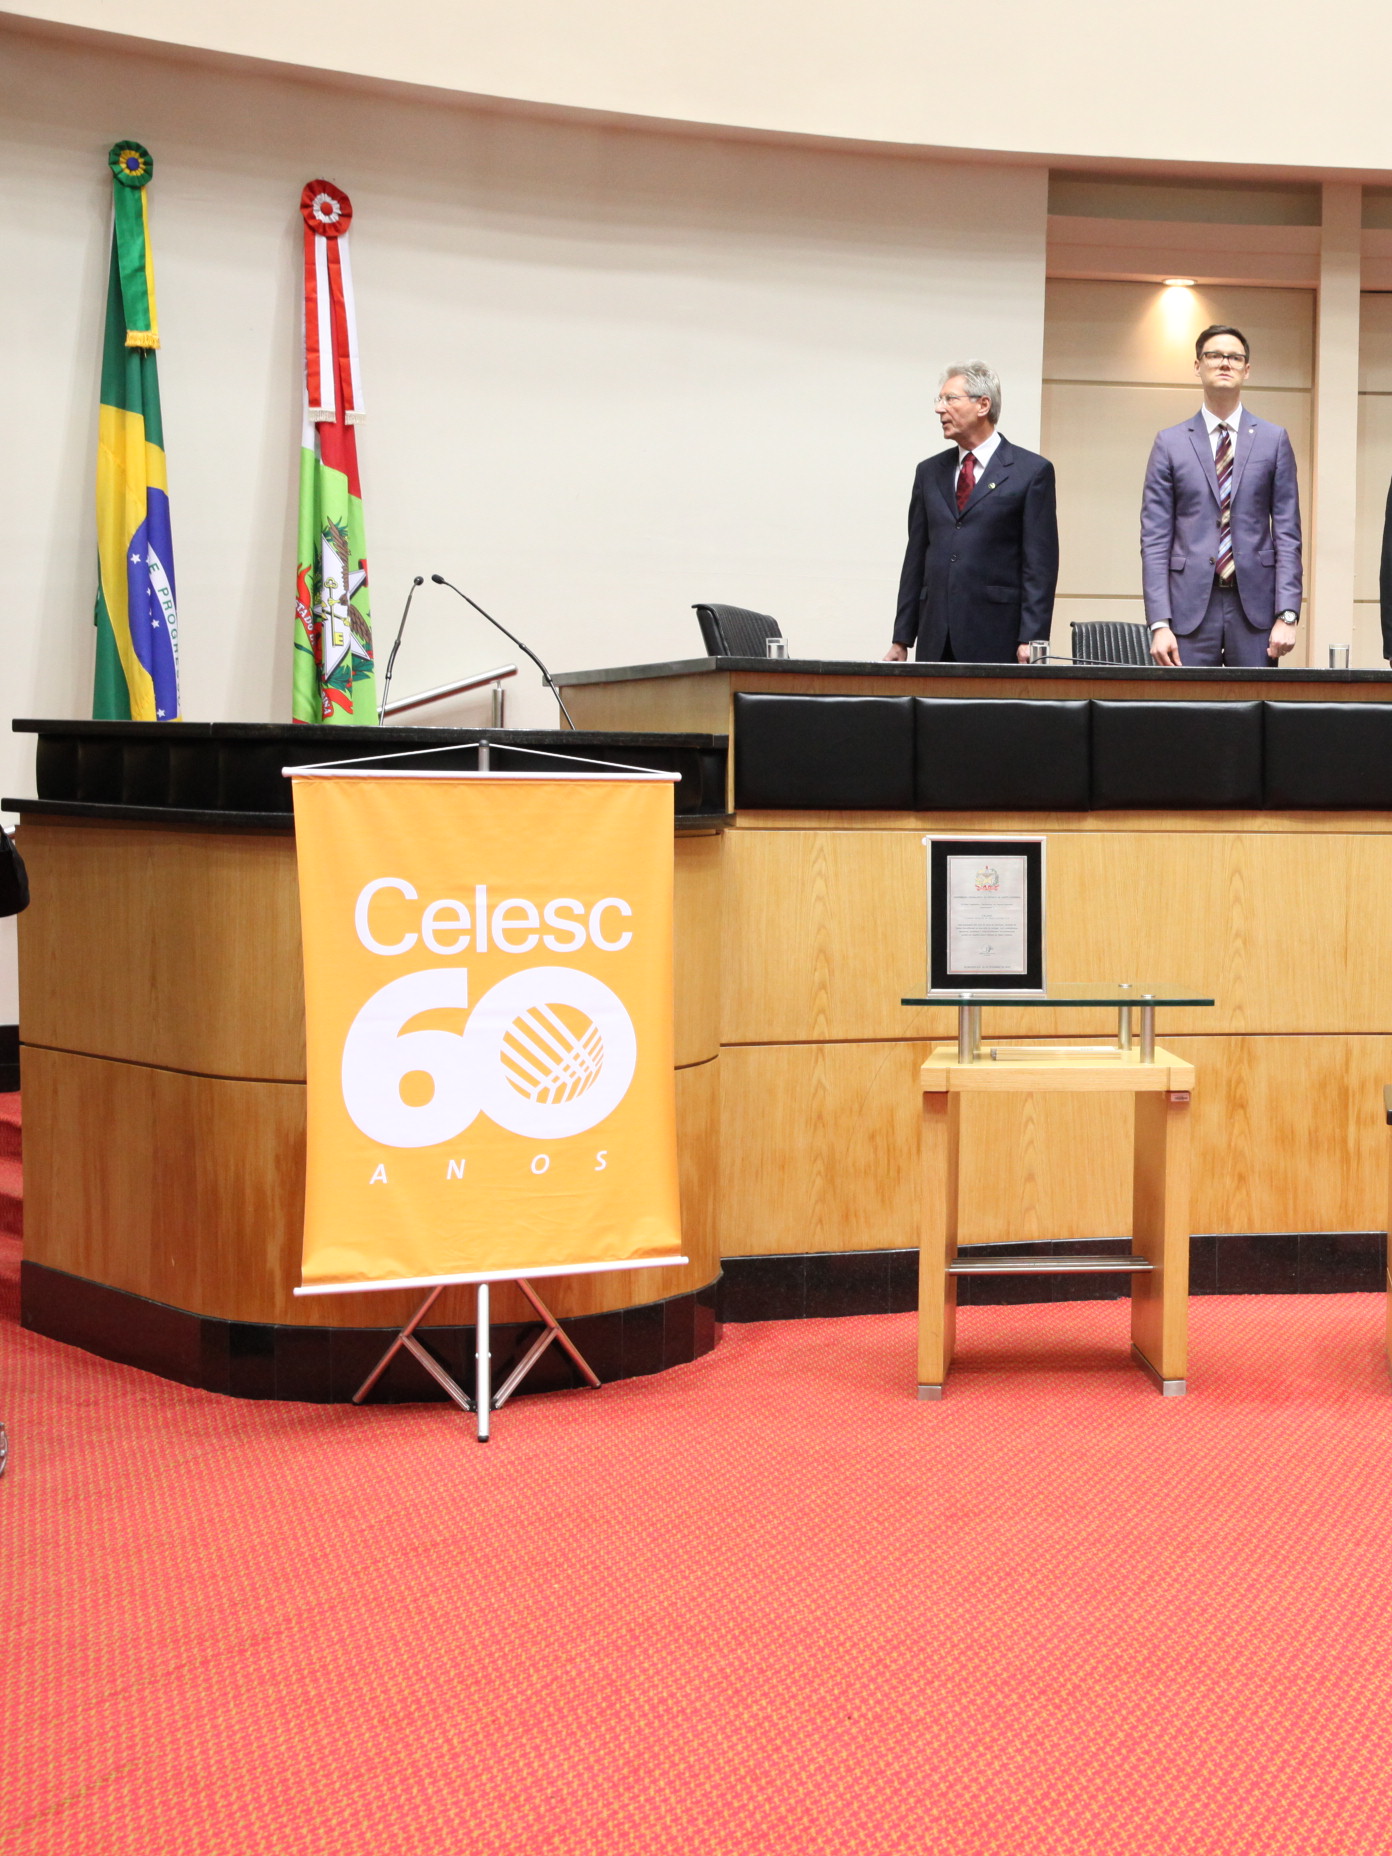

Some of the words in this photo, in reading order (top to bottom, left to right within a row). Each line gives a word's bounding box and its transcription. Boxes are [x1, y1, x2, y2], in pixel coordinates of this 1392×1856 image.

[148, 562, 160, 575] E
[354, 877, 634, 956] Celesc
[341, 965, 638, 1149] 60
